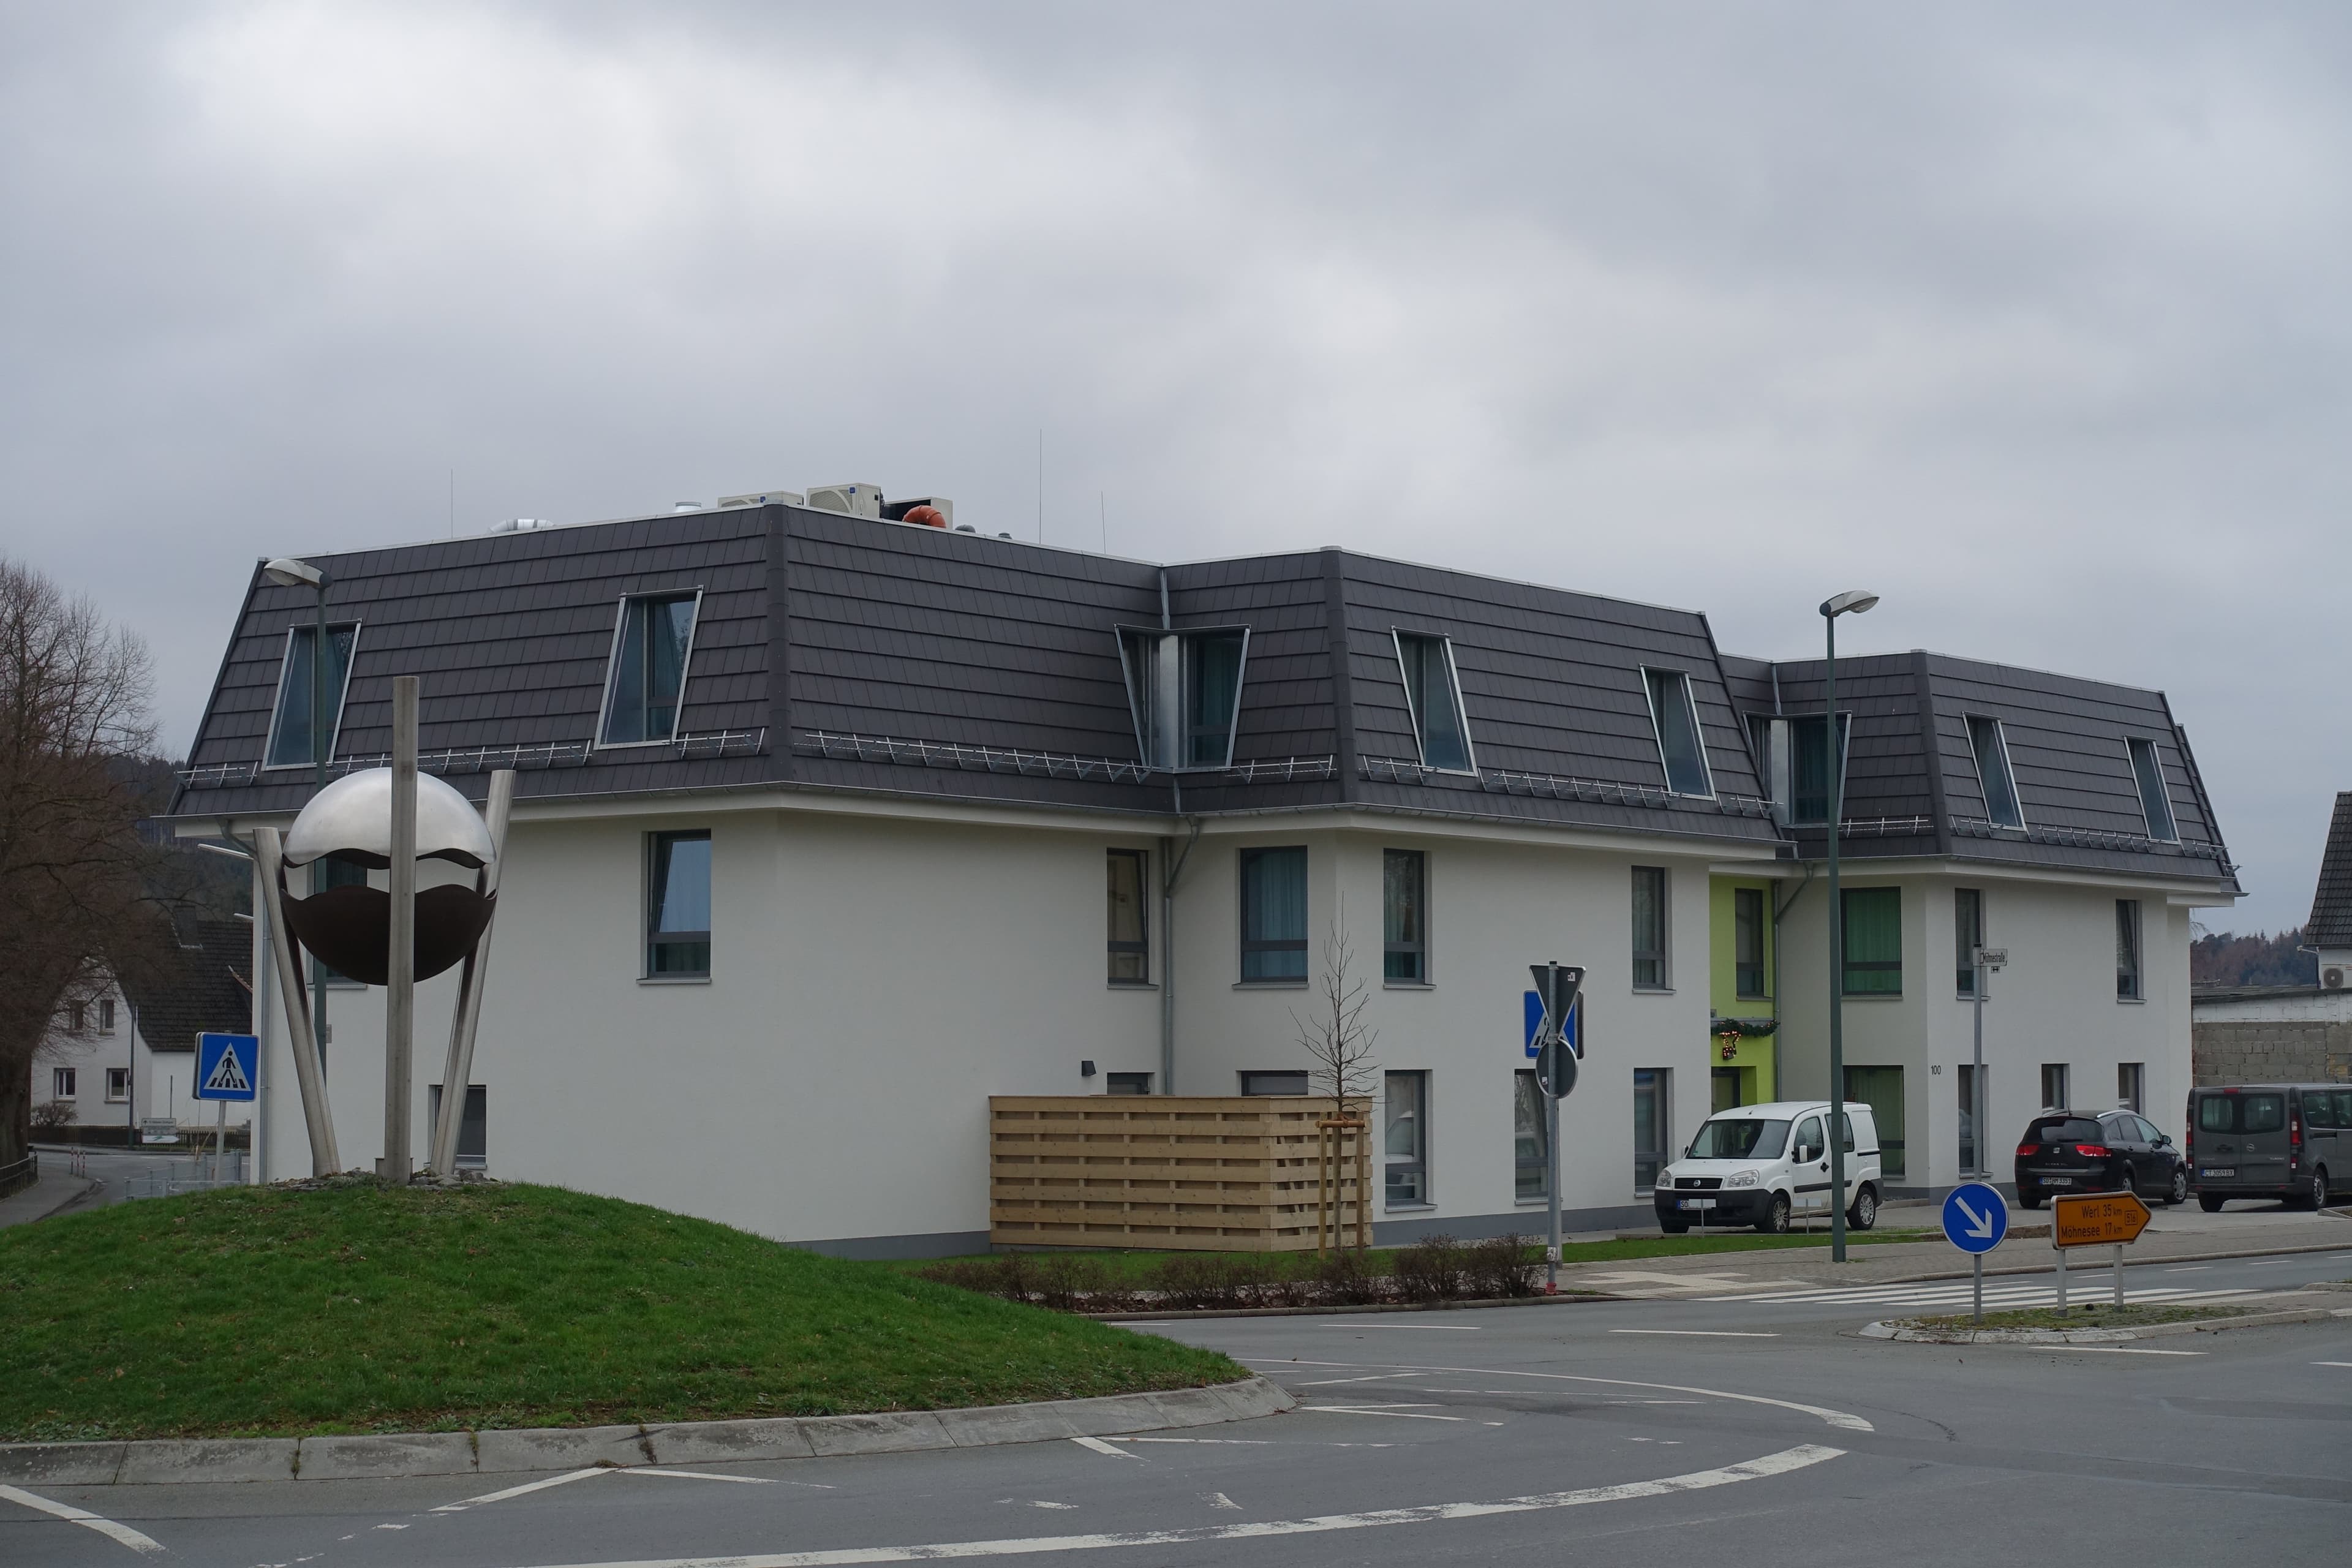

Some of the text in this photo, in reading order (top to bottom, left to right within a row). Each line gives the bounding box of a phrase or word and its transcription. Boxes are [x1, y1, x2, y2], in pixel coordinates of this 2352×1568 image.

[1931, 1065, 1942, 1075] 100
[2081, 1204, 2122, 1218] Werl 35 km
[2127, 1213, 2136, 1223] 516
[2061, 1222, 2123, 1238] Möhnesee 17 km
